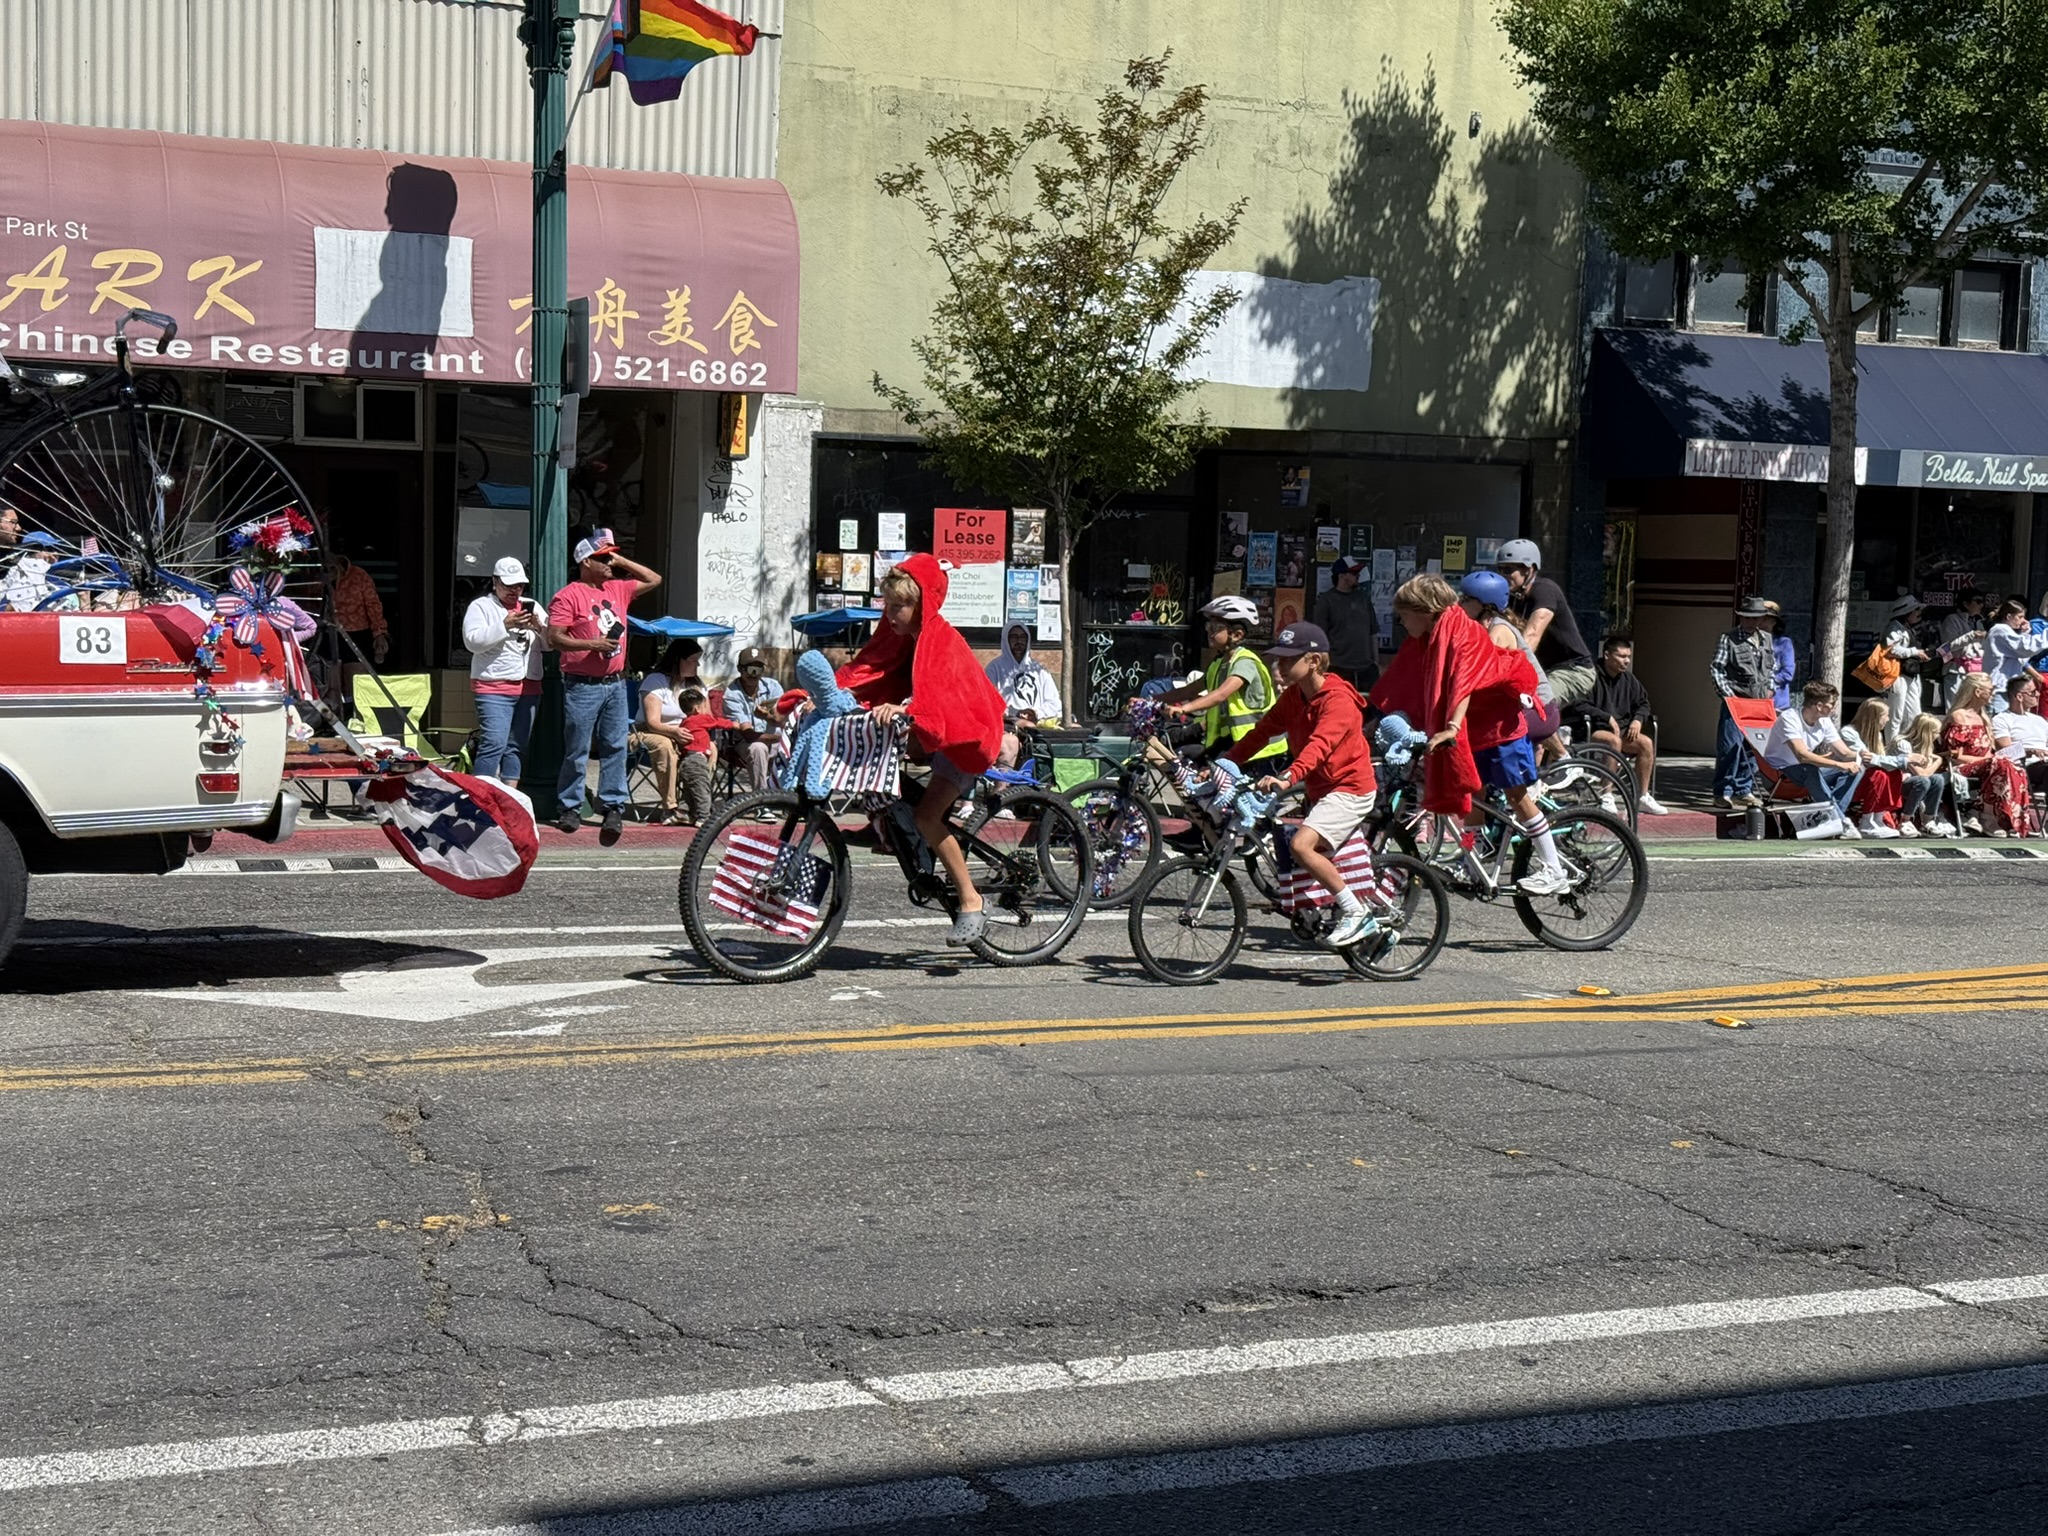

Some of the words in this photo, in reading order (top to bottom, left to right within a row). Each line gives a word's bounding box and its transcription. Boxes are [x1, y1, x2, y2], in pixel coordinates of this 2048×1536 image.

[6, 216, 58, 238] Park
[64, 221, 89, 241] St
[0, 244, 264, 325] ARK
[210, 335, 484, 375] Restaurant
[613, 355, 768, 387] 521-6862
[1926, 454, 1975, 485] Bella
[1975, 456, 2018, 486] Nail
[2019, 462, 2048, 491] Spa
[955, 511, 986, 528] For
[944, 528, 996, 546] Lease
[1446, 538, 1463, 547] IMP
[962, 571, 981, 581] Choi
[1943, 571, 1976, 591] TK
[1922, 591, 1955, 607] BARBER
[75, 626, 112, 654] 83
